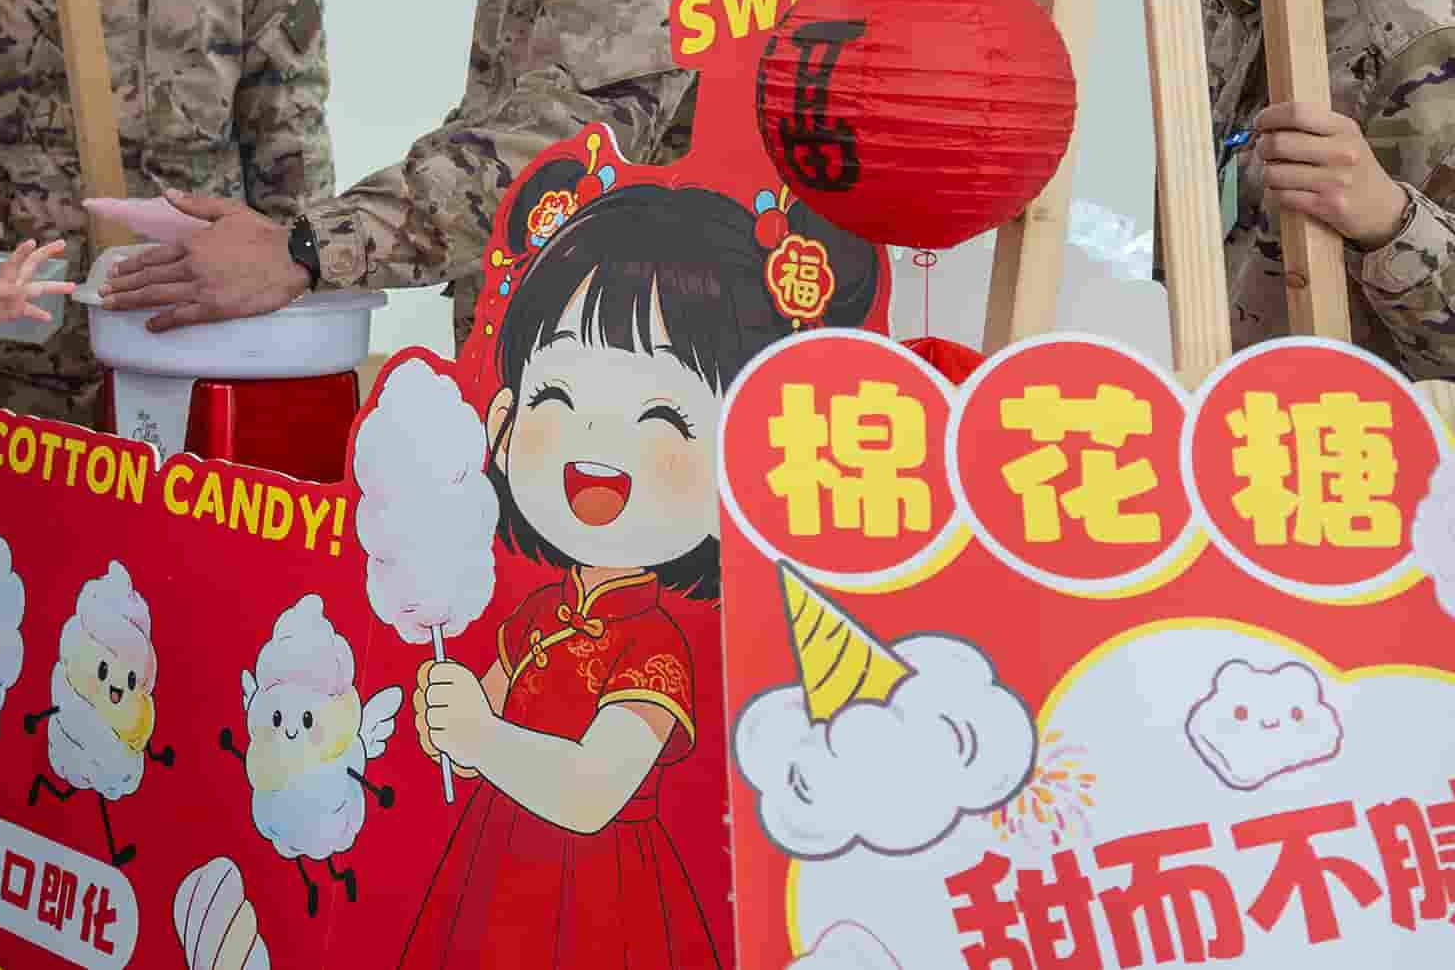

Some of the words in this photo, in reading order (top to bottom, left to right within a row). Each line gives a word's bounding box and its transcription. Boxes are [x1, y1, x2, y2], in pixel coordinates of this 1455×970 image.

[778, 249, 821, 307] 福
[164, 464, 347, 557] CANDY!
[768, 383, 1402, 546] 棉花糖
